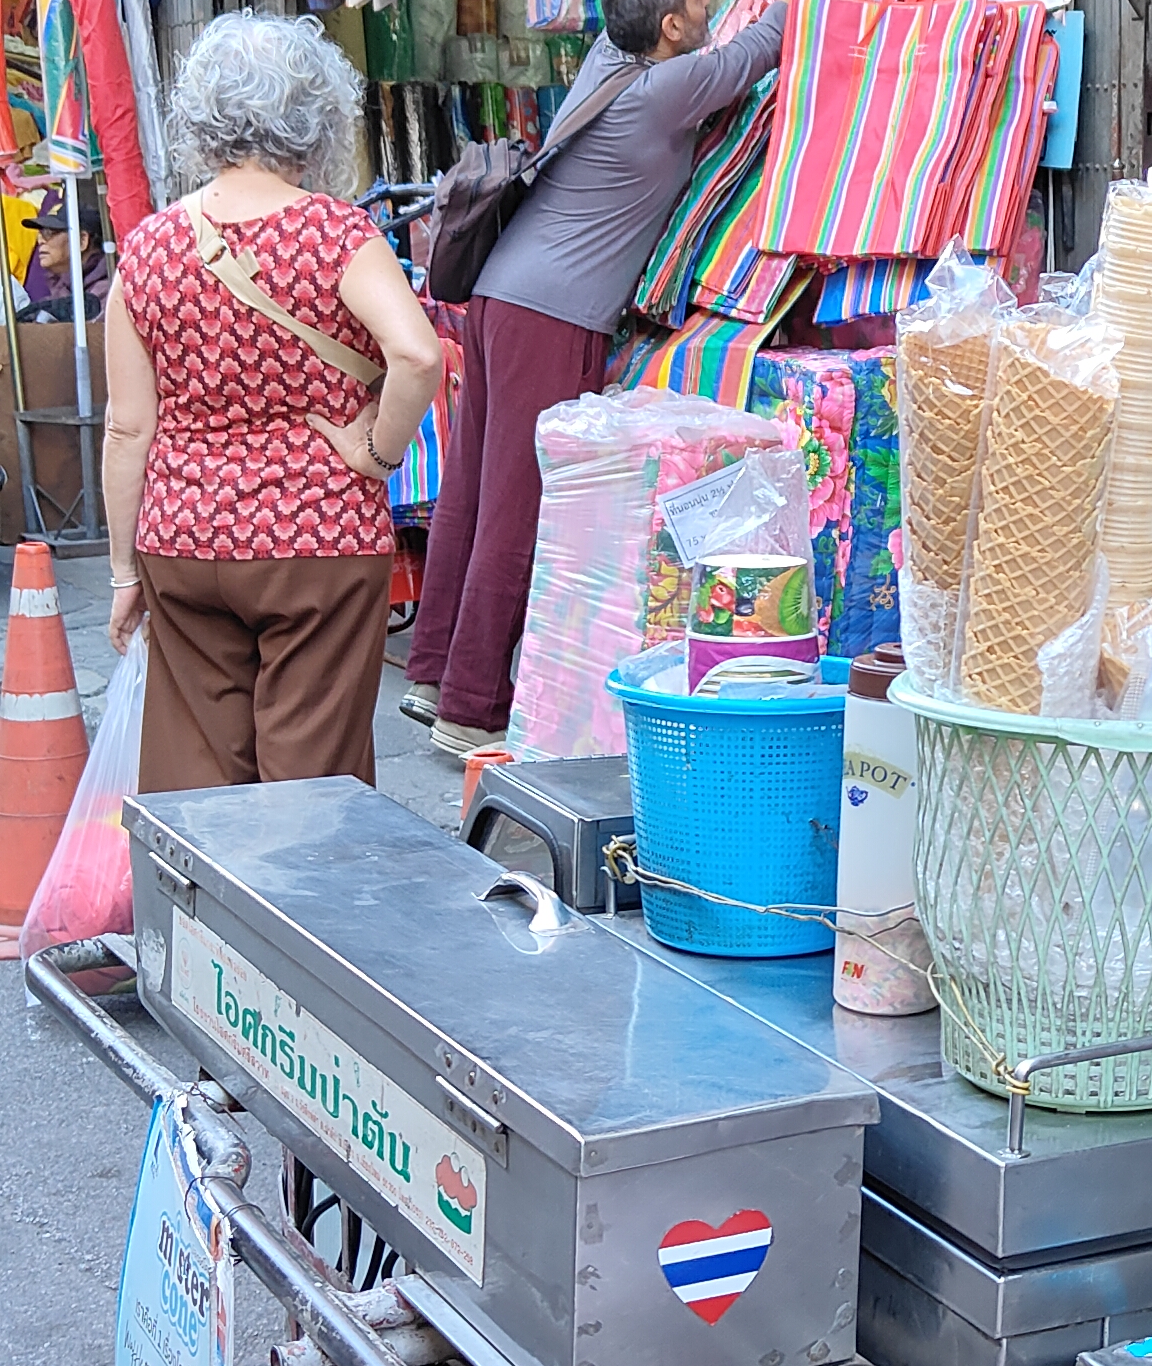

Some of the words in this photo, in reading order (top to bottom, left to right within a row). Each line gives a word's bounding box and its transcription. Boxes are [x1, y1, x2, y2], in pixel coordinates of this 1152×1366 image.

[843, 759, 908, 791] APOT
[211, 958, 411, 1184] ไอศกรีมป่าตัน
